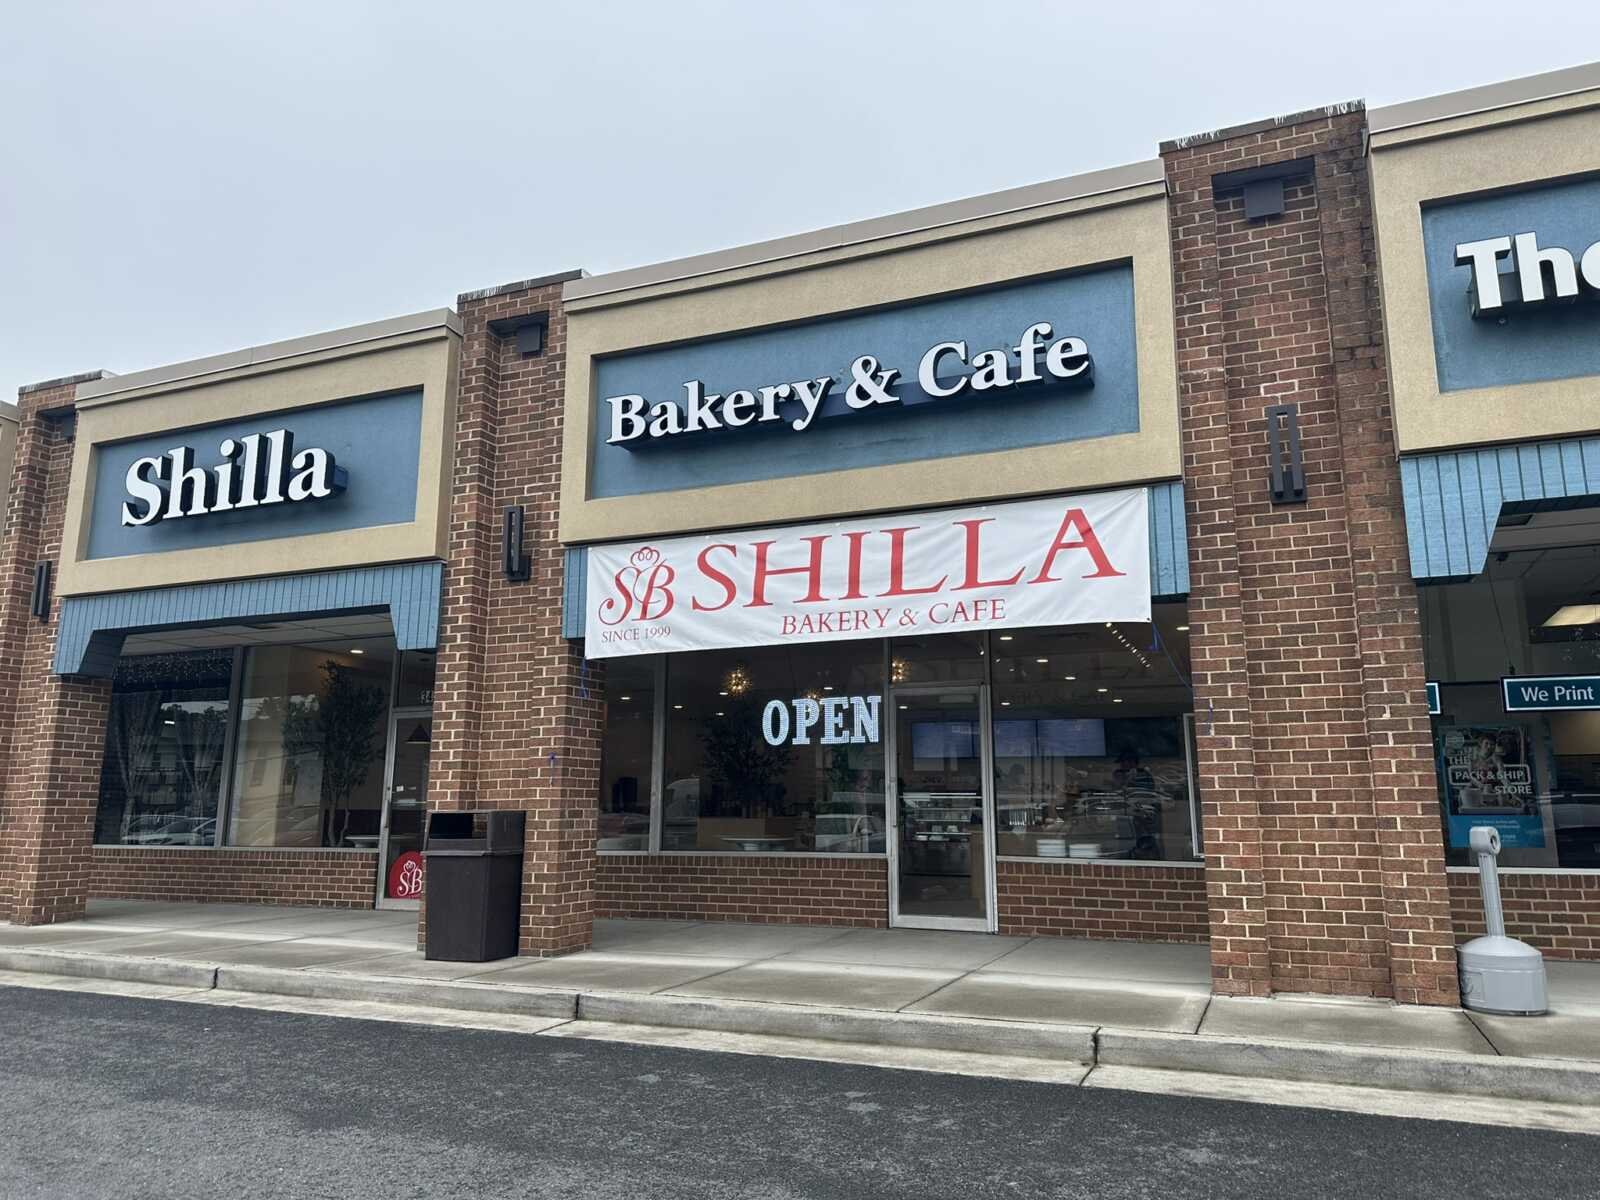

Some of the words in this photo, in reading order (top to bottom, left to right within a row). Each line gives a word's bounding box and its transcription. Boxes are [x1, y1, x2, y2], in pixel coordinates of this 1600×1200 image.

[605, 379, 833, 445] Bakery
[844, 354, 900, 410] &
[917, 321, 1090, 398] Cafe
[121, 429, 332, 526] Shilla
[691, 507, 1128, 613] SHILLA
[601, 628, 640, 644] SINCE
[644, 625, 672, 639] 1999
[782, 608, 893, 636] BAKERY
[898, 607, 918, 627] &
[927, 598, 1007, 625] CAFE
[1521, 686, 1550, 702] We
[1553, 685, 1595, 701] Print
[762, 695, 882, 746] OPEN
[1494, 785, 1533, 794] STORE
